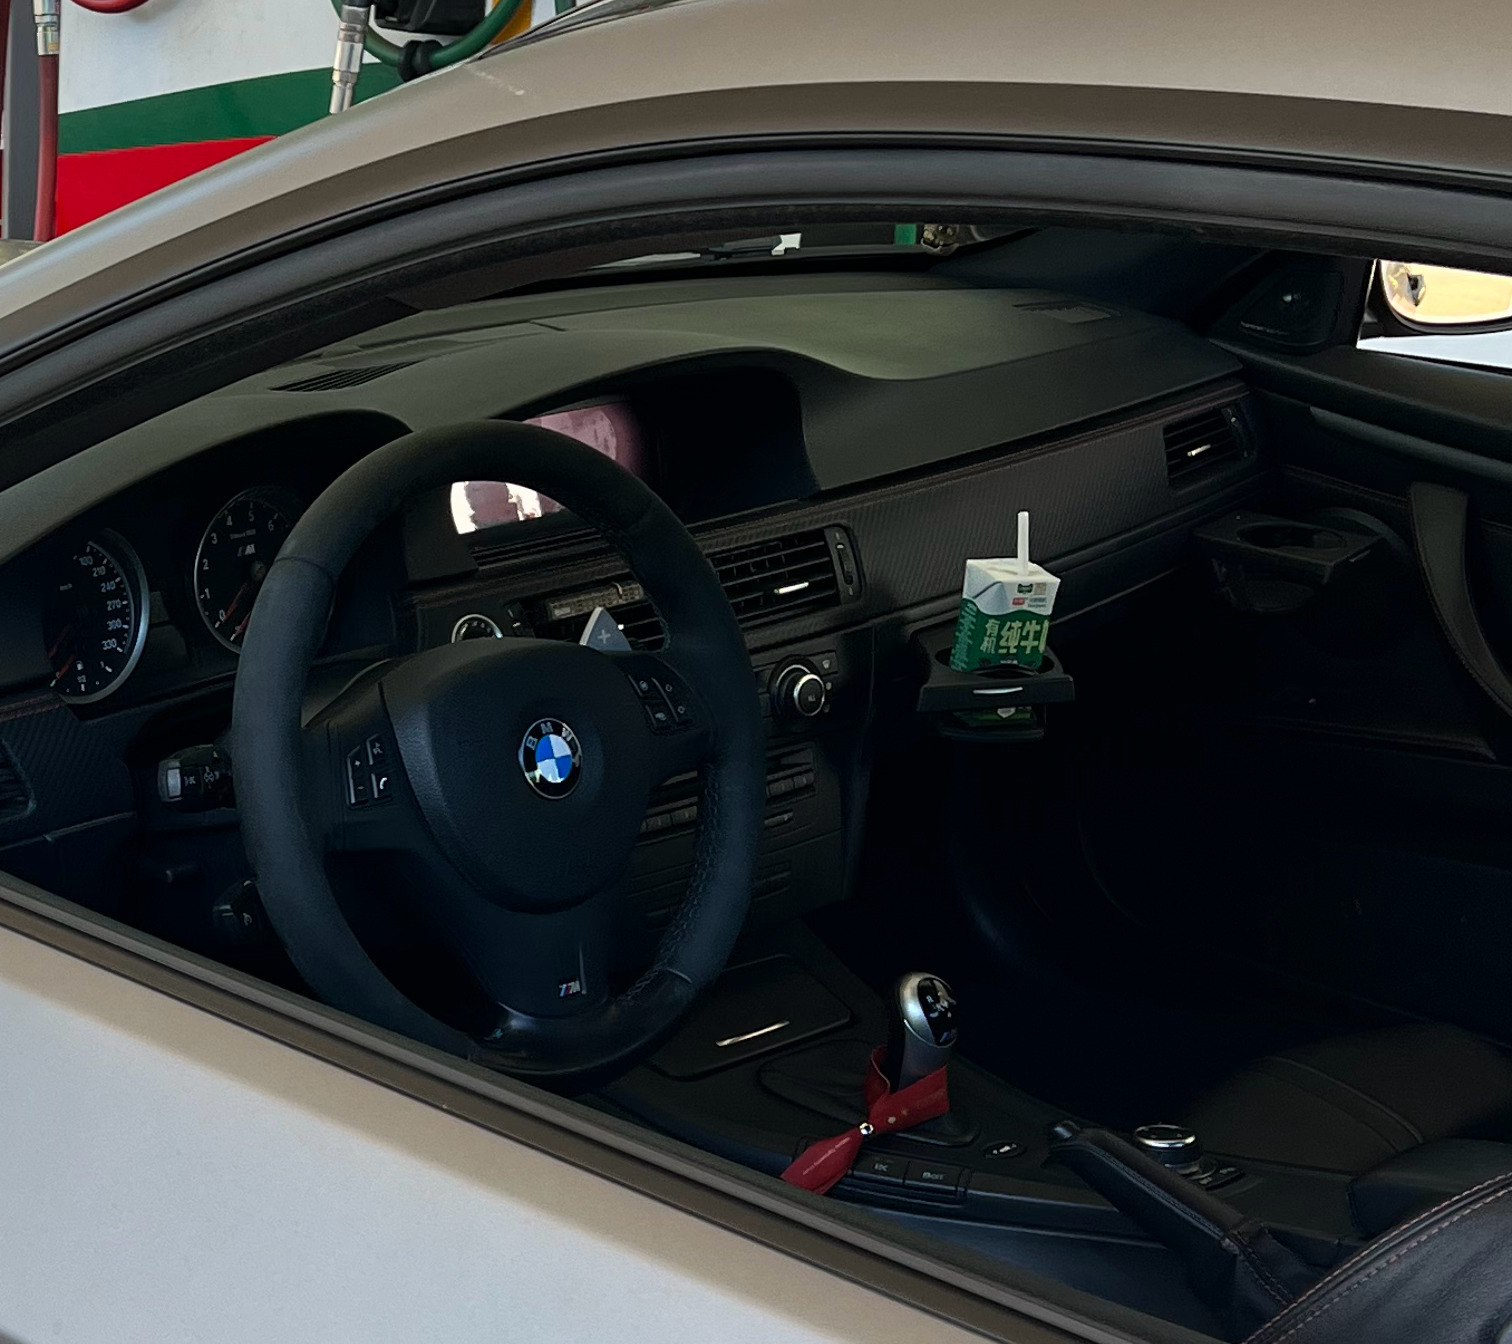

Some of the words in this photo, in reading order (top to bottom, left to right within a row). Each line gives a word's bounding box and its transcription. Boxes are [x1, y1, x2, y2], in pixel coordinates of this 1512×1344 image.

[101, 638, 117, 650] 330
[980, 618, 1000, 654] 有机
[526, 722, 572, 751] BMW
